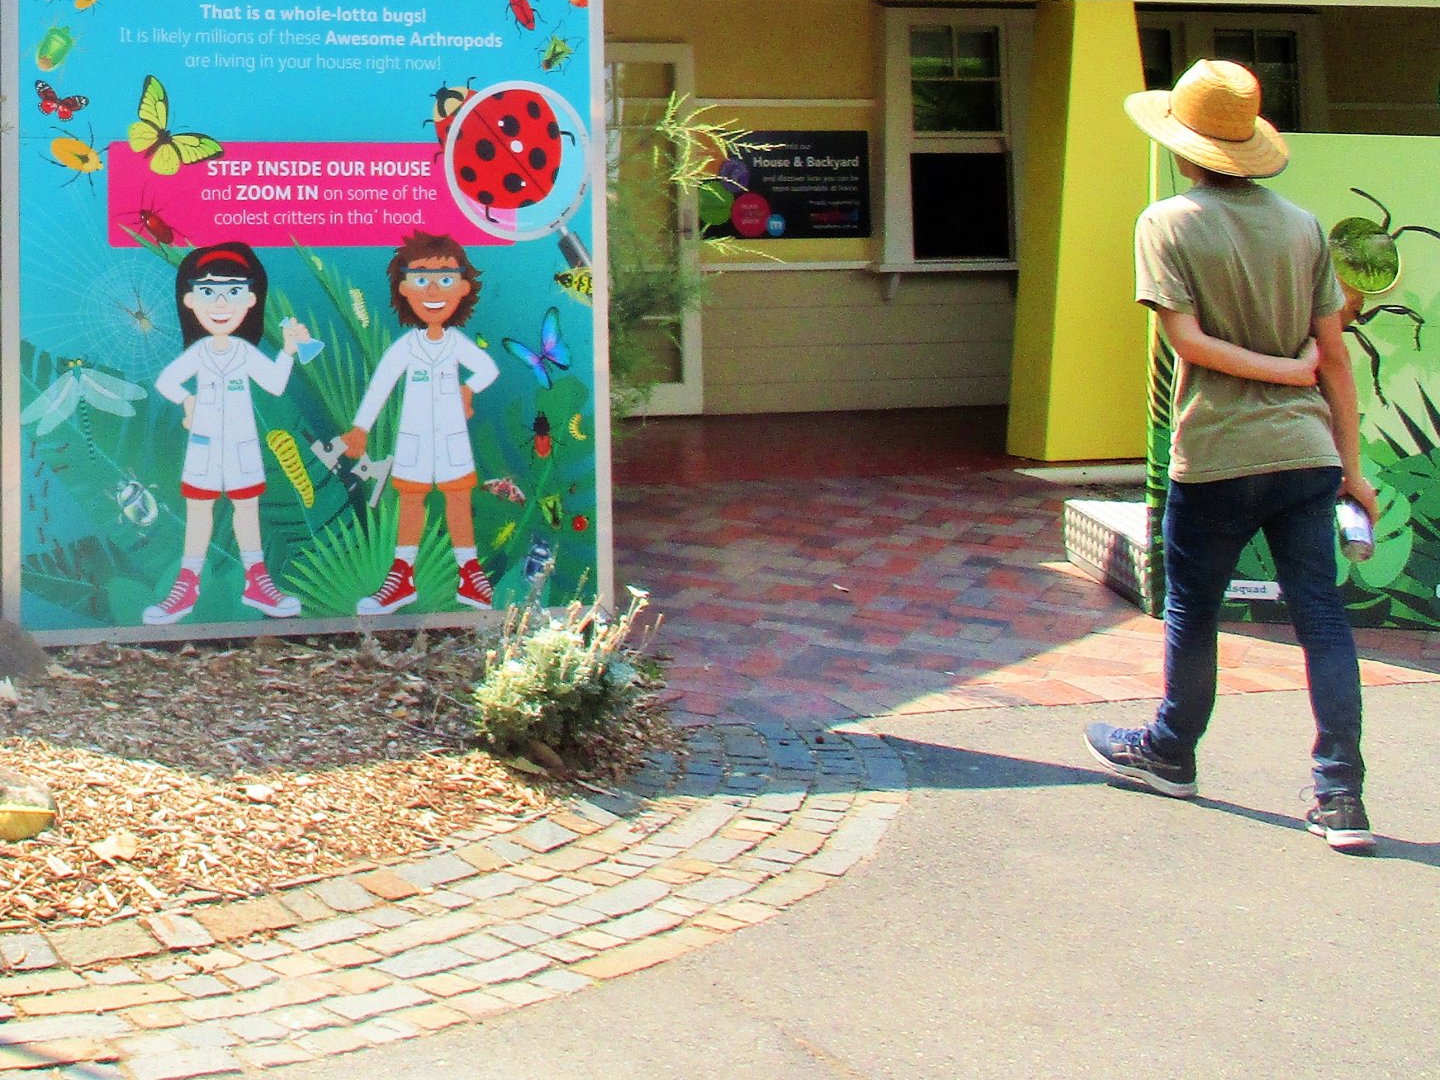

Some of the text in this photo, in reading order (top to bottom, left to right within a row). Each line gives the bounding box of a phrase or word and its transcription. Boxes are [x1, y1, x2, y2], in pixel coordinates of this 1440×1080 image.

[200, 3, 427, 27] That is a whole-lotta bugs!
[119, 27, 503, 49] It is likely millions of these Awesome Arthropods
[185, 53, 441, 73] are living in your house right now!
[207, 161, 431, 177] STEP INSIDE OUR HOUSE
[753, 156, 859, 170] House & Backyard
[201, 185, 437, 201] and ZOOM IN on some of the
[214, 209, 426, 225] coolest critters in tha' hood.
